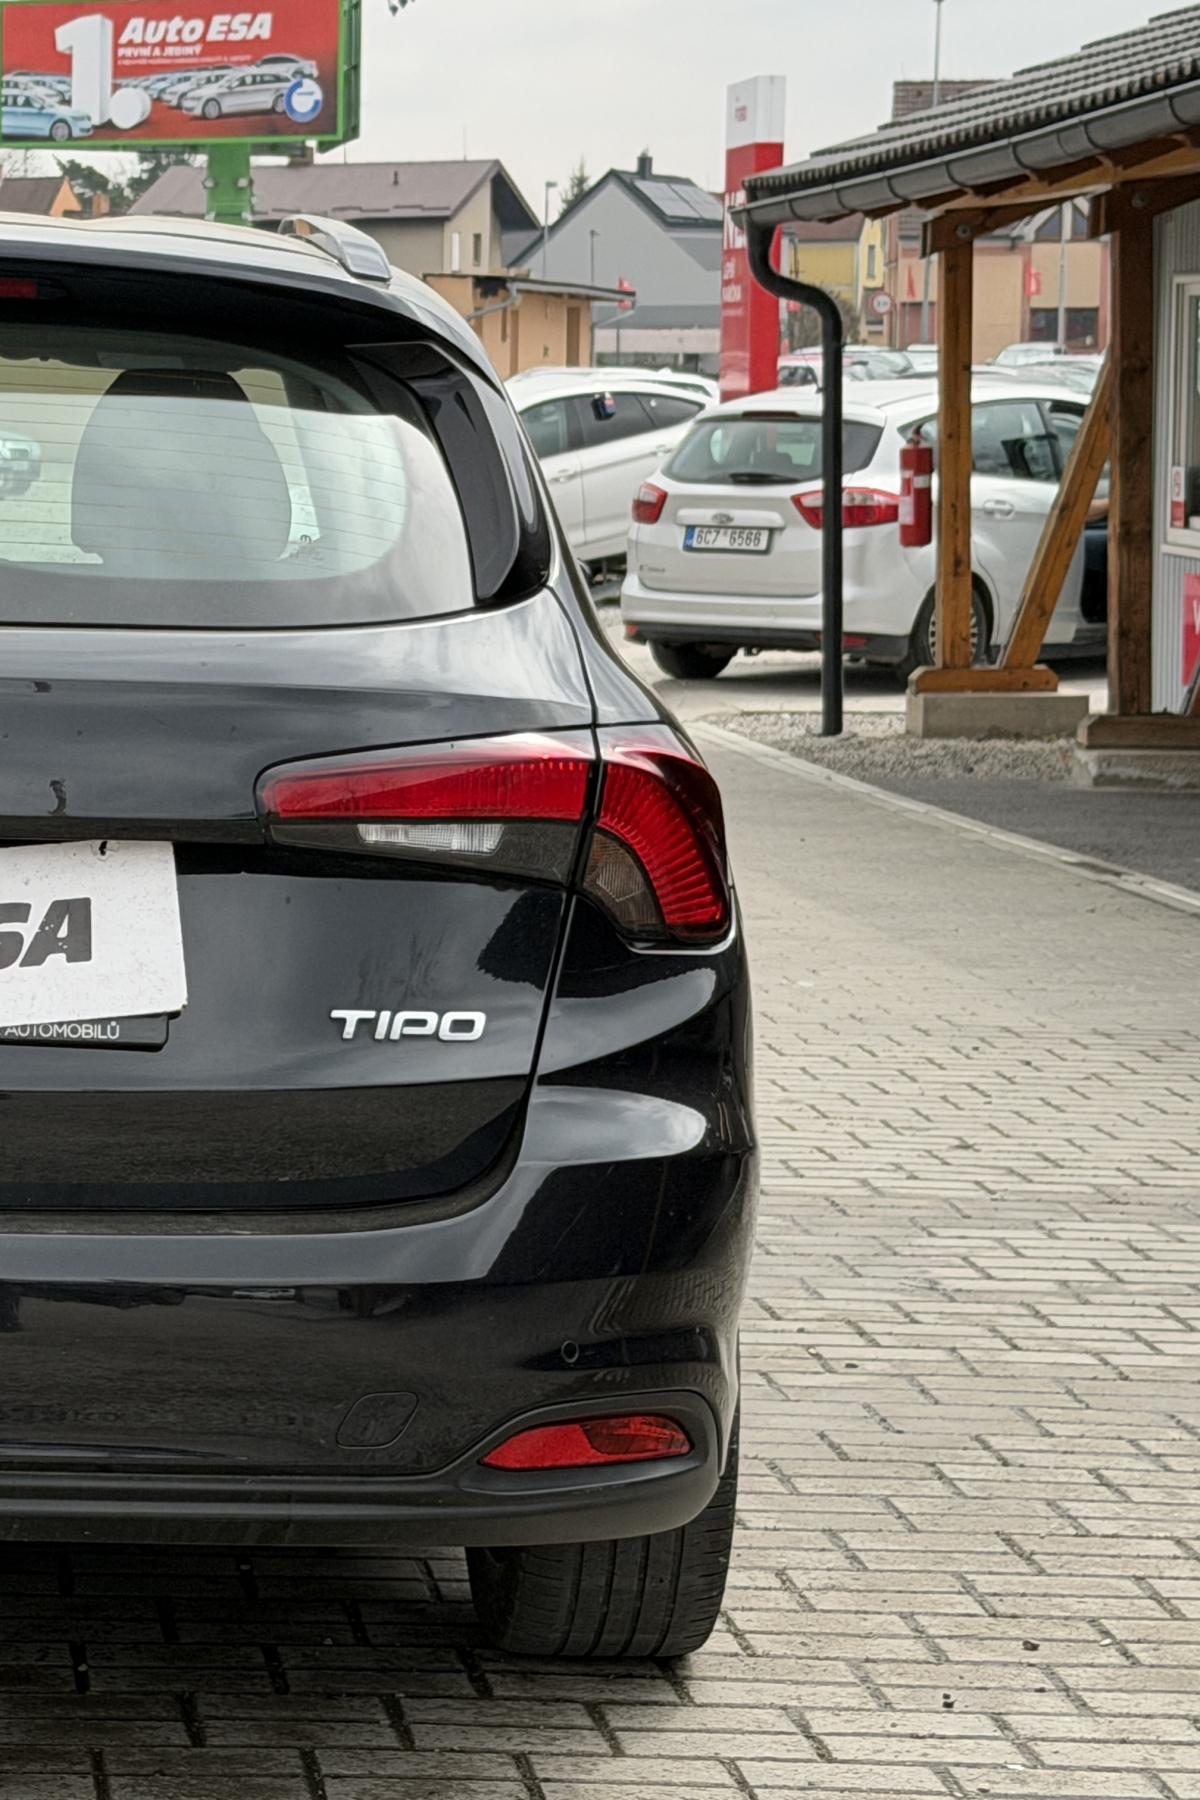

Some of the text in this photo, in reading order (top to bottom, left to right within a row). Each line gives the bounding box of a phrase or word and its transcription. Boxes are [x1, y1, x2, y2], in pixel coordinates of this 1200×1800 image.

[118, 13, 272, 44] Auto ESA
[330, 1009, 487, 1041] TIPO
